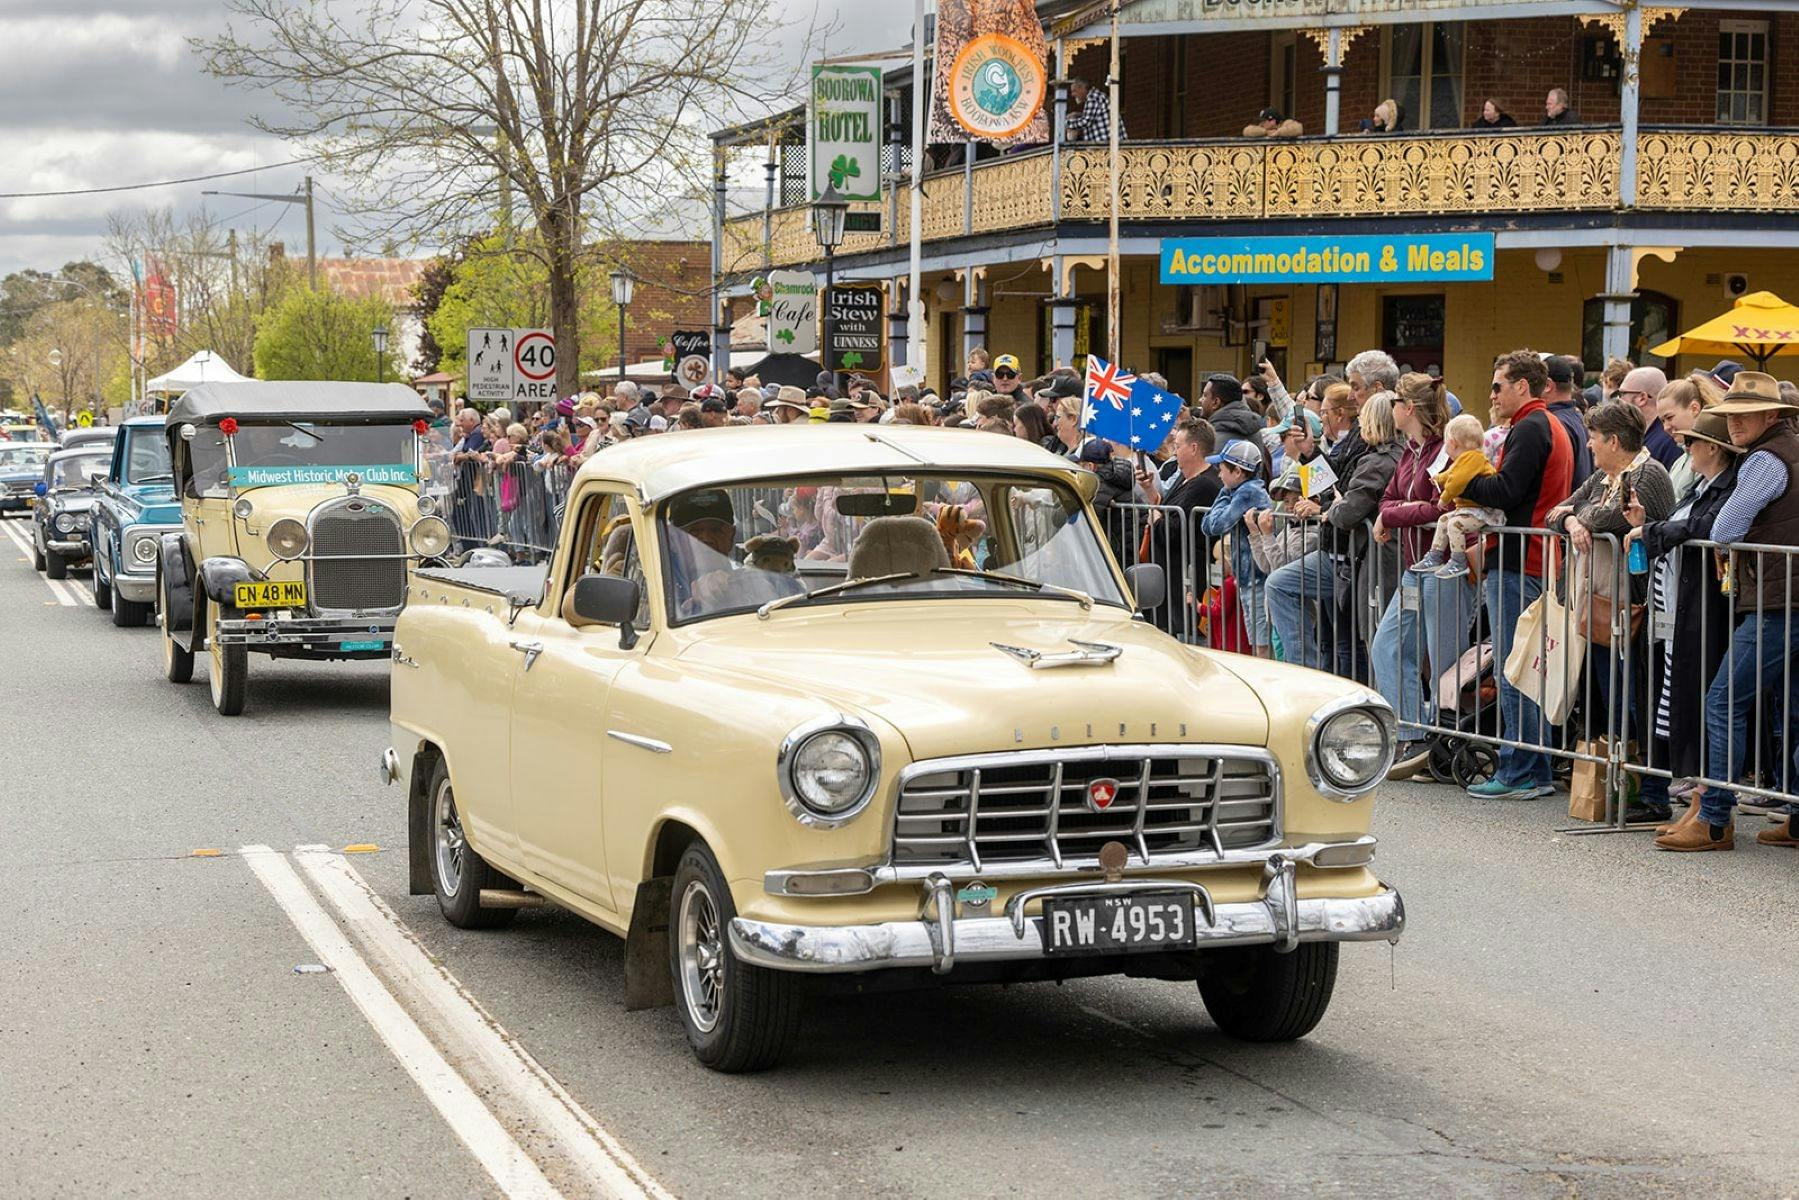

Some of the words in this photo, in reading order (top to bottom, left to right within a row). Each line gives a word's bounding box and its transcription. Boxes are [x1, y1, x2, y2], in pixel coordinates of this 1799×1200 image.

[817, 77, 875, 102] BOOROWA
[818, 111, 872, 143] HOTEL
[1169, 246, 1370, 274] Accommodation
[1379, 245, 1399, 272] &
[1408, 244, 1484, 272] Meals
[774, 281, 815, 295] Shamrock
[831, 291, 878, 306] Irish
[772, 300, 816, 330] Cafe
[831, 306, 878, 321] Stew
[840, 323, 866, 332] with
[1732, 325, 1799, 340] XXX
[673, 335, 709, 351] Coffee
[833, 336, 879, 348] UINNESS
[521, 345, 555, 368] 40
[516, 383, 558, 398] AREA
[248, 470, 292, 484] Midwest
[293, 469, 333, 483] Historic
[366, 468, 389, 482] Club
[391, 468, 409, 481] Inc.
[1105, 898, 1132, 907] NSW
